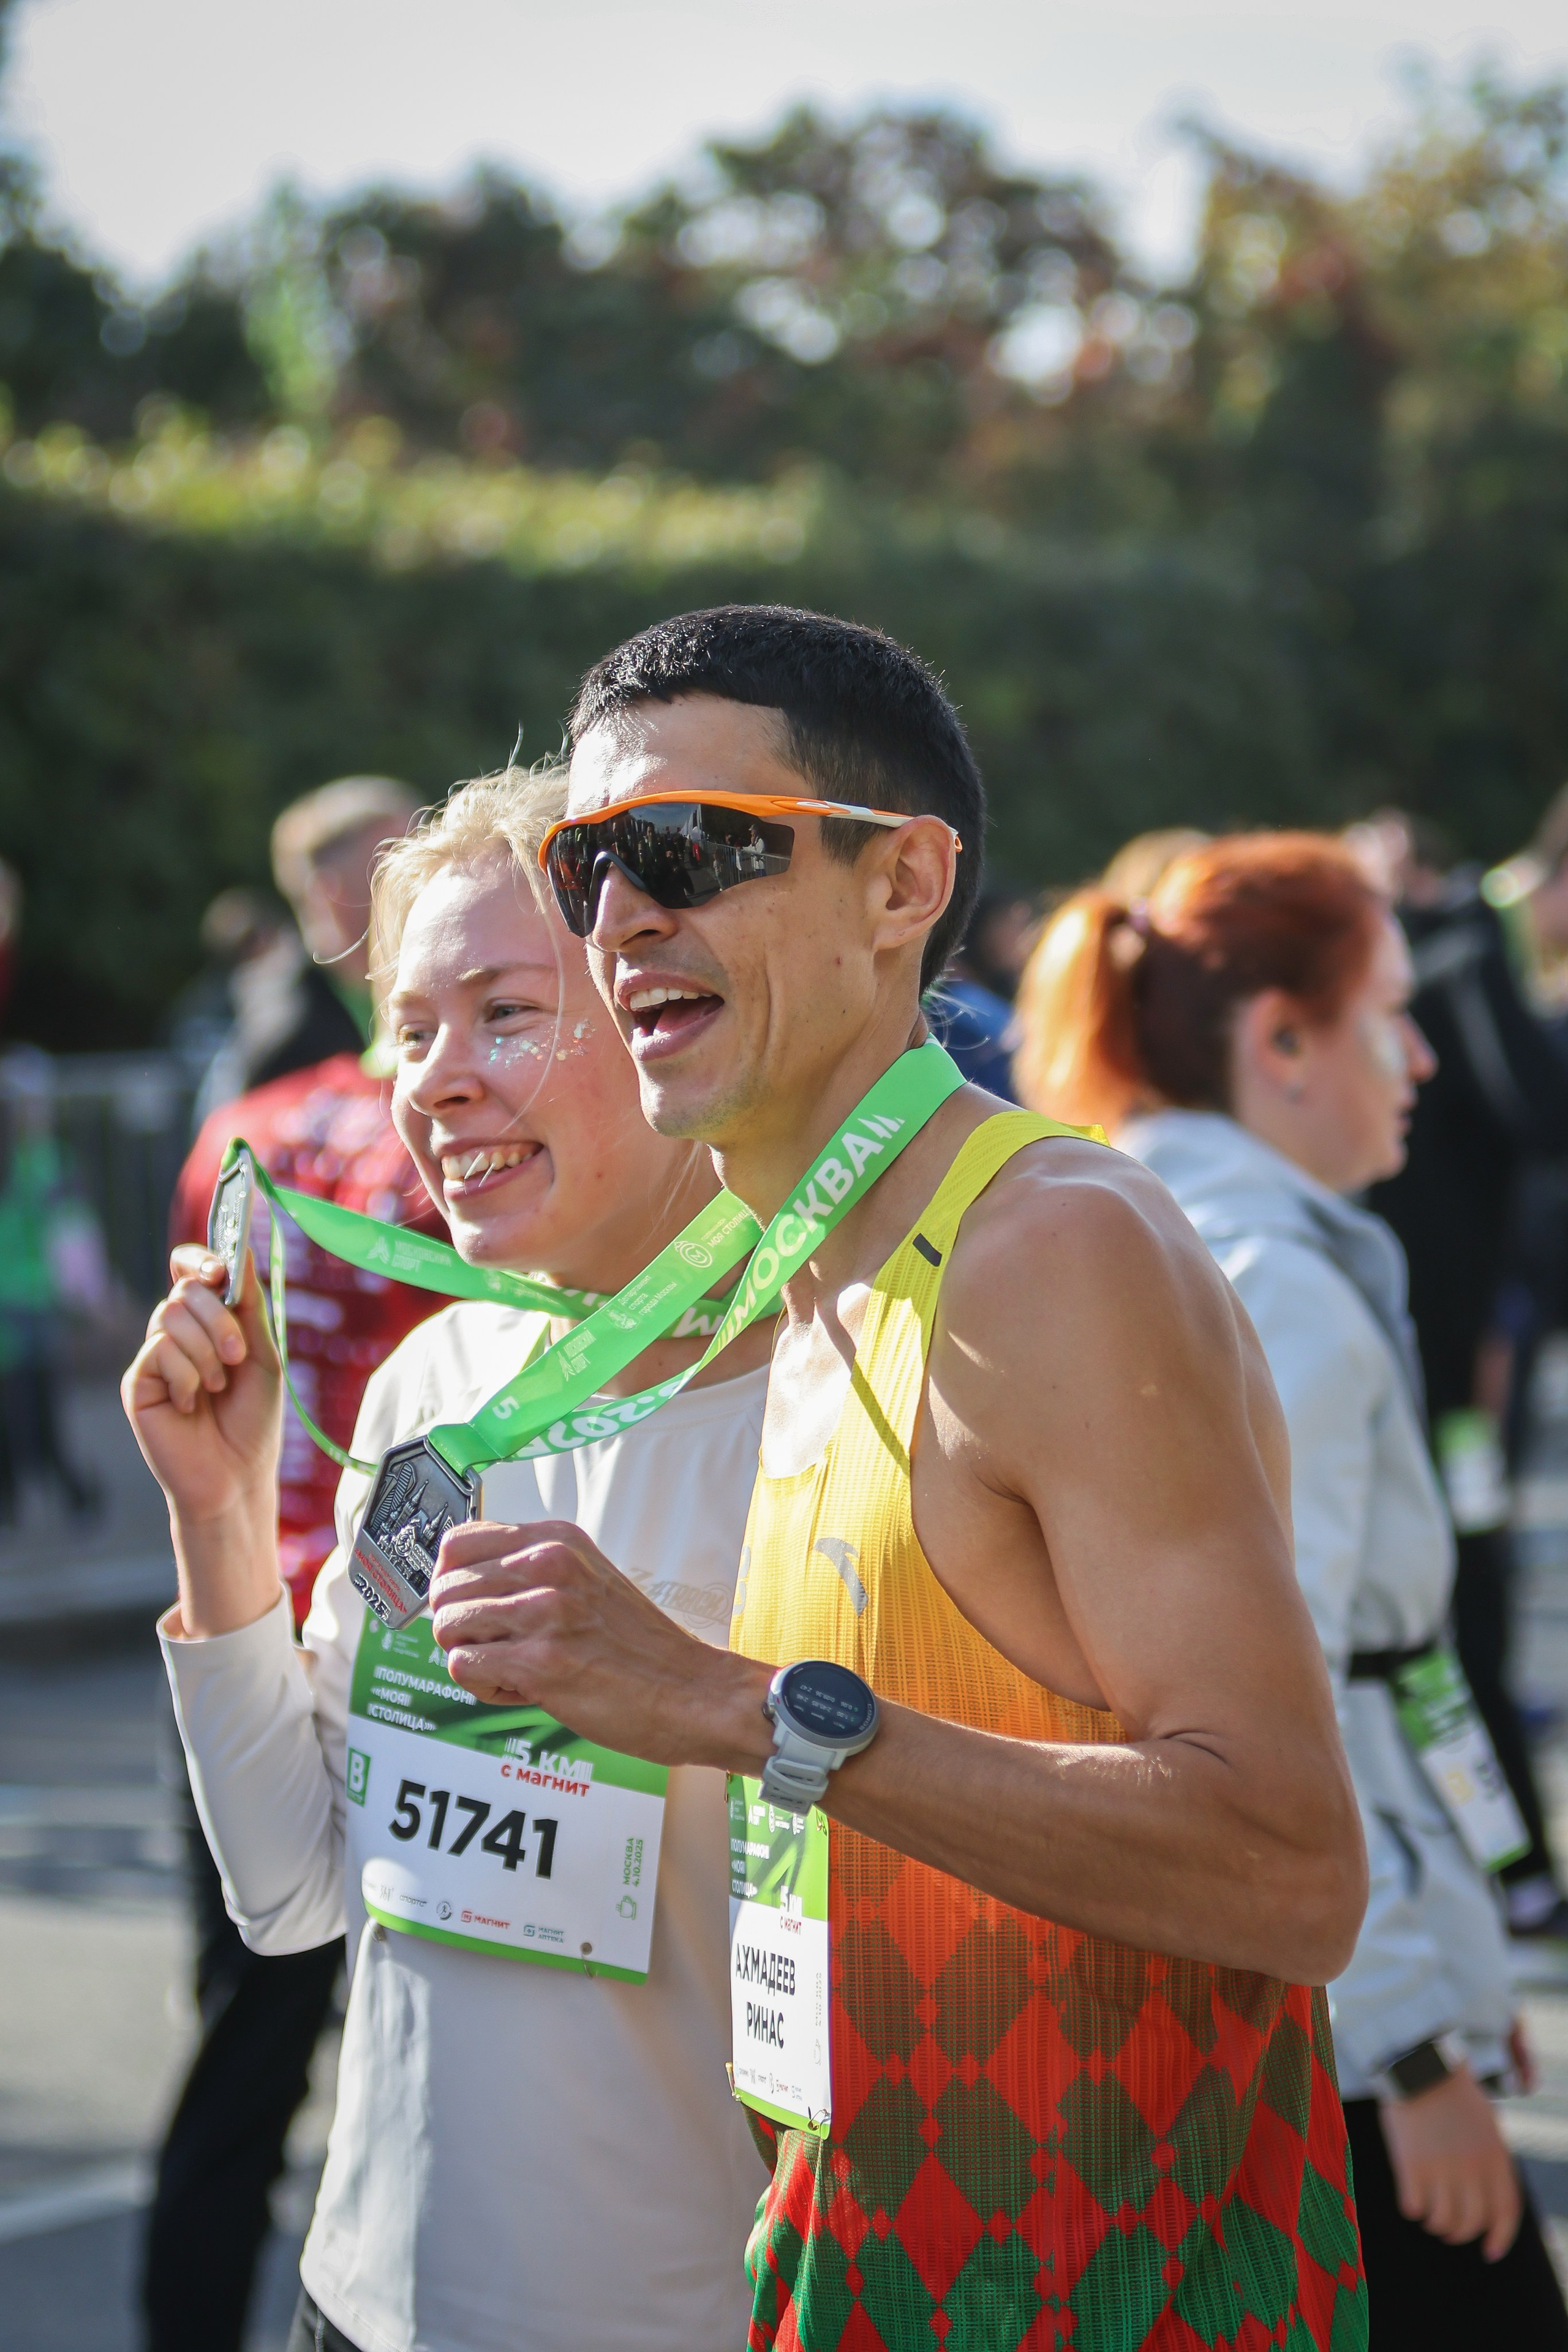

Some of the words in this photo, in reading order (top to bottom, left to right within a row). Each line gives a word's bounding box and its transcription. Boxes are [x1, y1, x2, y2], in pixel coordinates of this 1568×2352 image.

[707, 1232, 725, 1248] МОЯ
[722, 1209, 750, 1234] СТОЛИЦ
[730, 1127, 888, 1338] МОСКВА
[617, 1275, 652, 1306] Департамент
[628, 1293, 648, 1310] спорта
[638, 1298, 659, 1316] города
[654, 1281, 677, 1300] Москвы
[492, 1395, 519, 1420] 5
[374, 1665, 478, 1706] ПОЛУМАРАФОН
[508, 1737, 532, 1765] 5
[388, 1779, 559, 1880] 51741
[622, 1837, 635, 1885] МОСКВА
[632, 1839, 644, 1888] 4.10.2025
[474, 1915, 510, 1930] МАГНИТ
[736, 1943, 796, 1997] АХМАДЕЕВ
[746, 2001, 785, 2049] РИНАС
